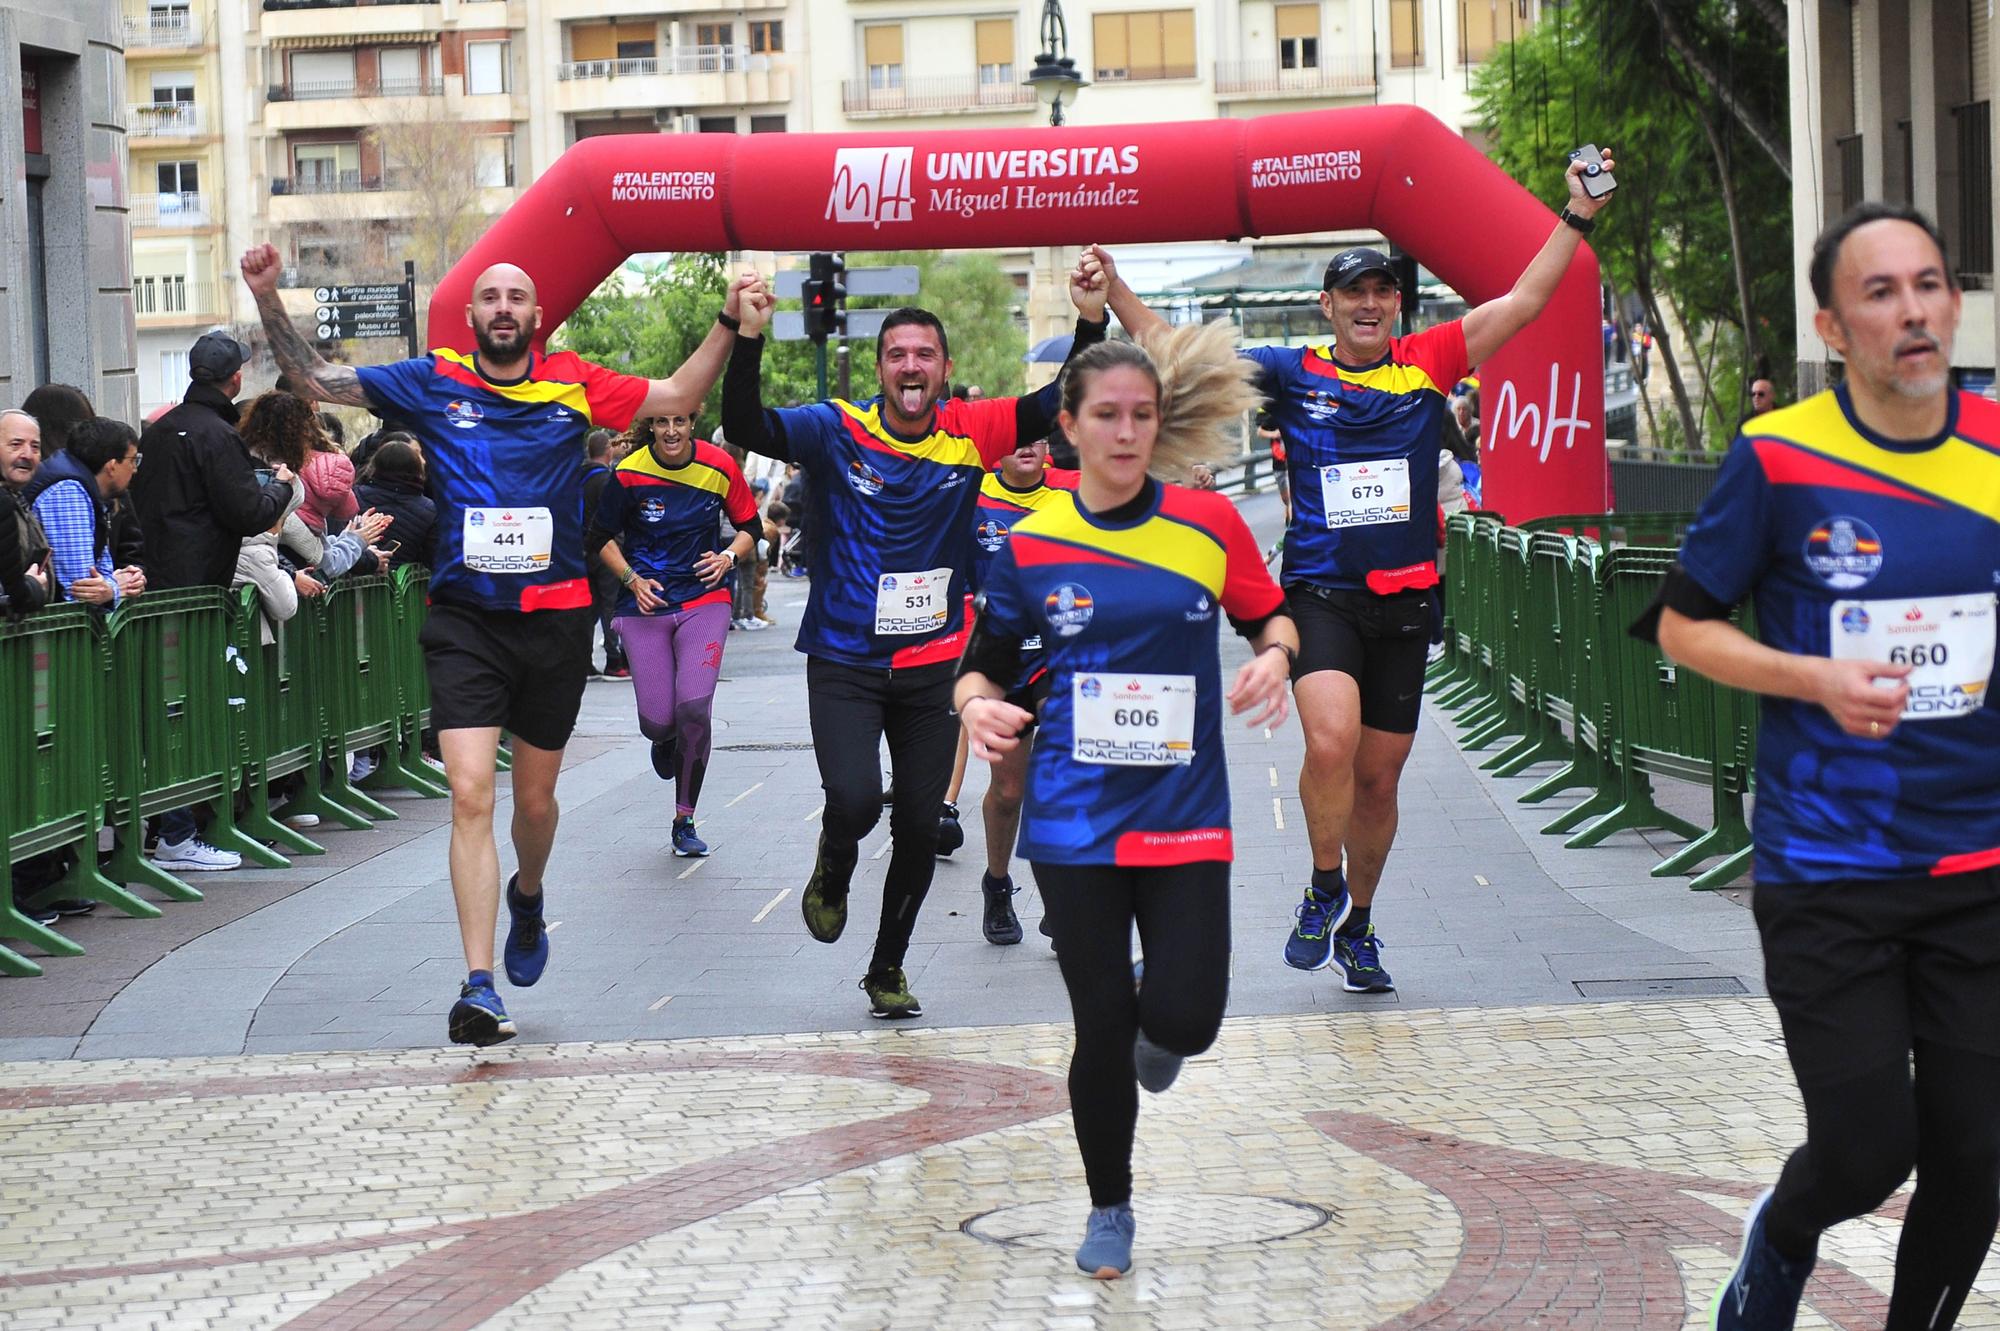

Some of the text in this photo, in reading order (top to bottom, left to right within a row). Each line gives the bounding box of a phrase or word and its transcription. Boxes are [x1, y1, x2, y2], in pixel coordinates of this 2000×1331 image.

[926, 145, 1139, 181] UNIVERSITAS
[1251, 150, 1361, 173] #TALENTOEN
[613, 171, 716, 186] #TALENTOEN
[1252, 165, 1361, 188] MOVIMIENTO
[612, 186, 715, 200] MOVIMIENTO
[928, 182, 1139, 217] Miguel Hernández
[342, 285, 398, 295] Centre municipal
[376, 303, 399, 311] Museu
[358, 322, 381, 330] Museu
[1352, 485, 1384, 499] 679
[1328, 506, 1394, 518] POLICIA
[1329, 513, 1408, 526] NACIONAL
[493, 533, 524, 545] 441
[466, 554, 533, 562] POLICIA
[466, 562, 548, 570] NACIONAL
[905, 594, 932, 608] 531
[878, 614, 937, 625] POLICIA
[878, 620, 946, 632] NACIONAL
[1890, 643, 1948, 667] 660
[1115, 709, 1159, 727] 606
[1078, 738, 1168, 750] POLICIA
[1078, 748, 1189, 761] NACIONAL
